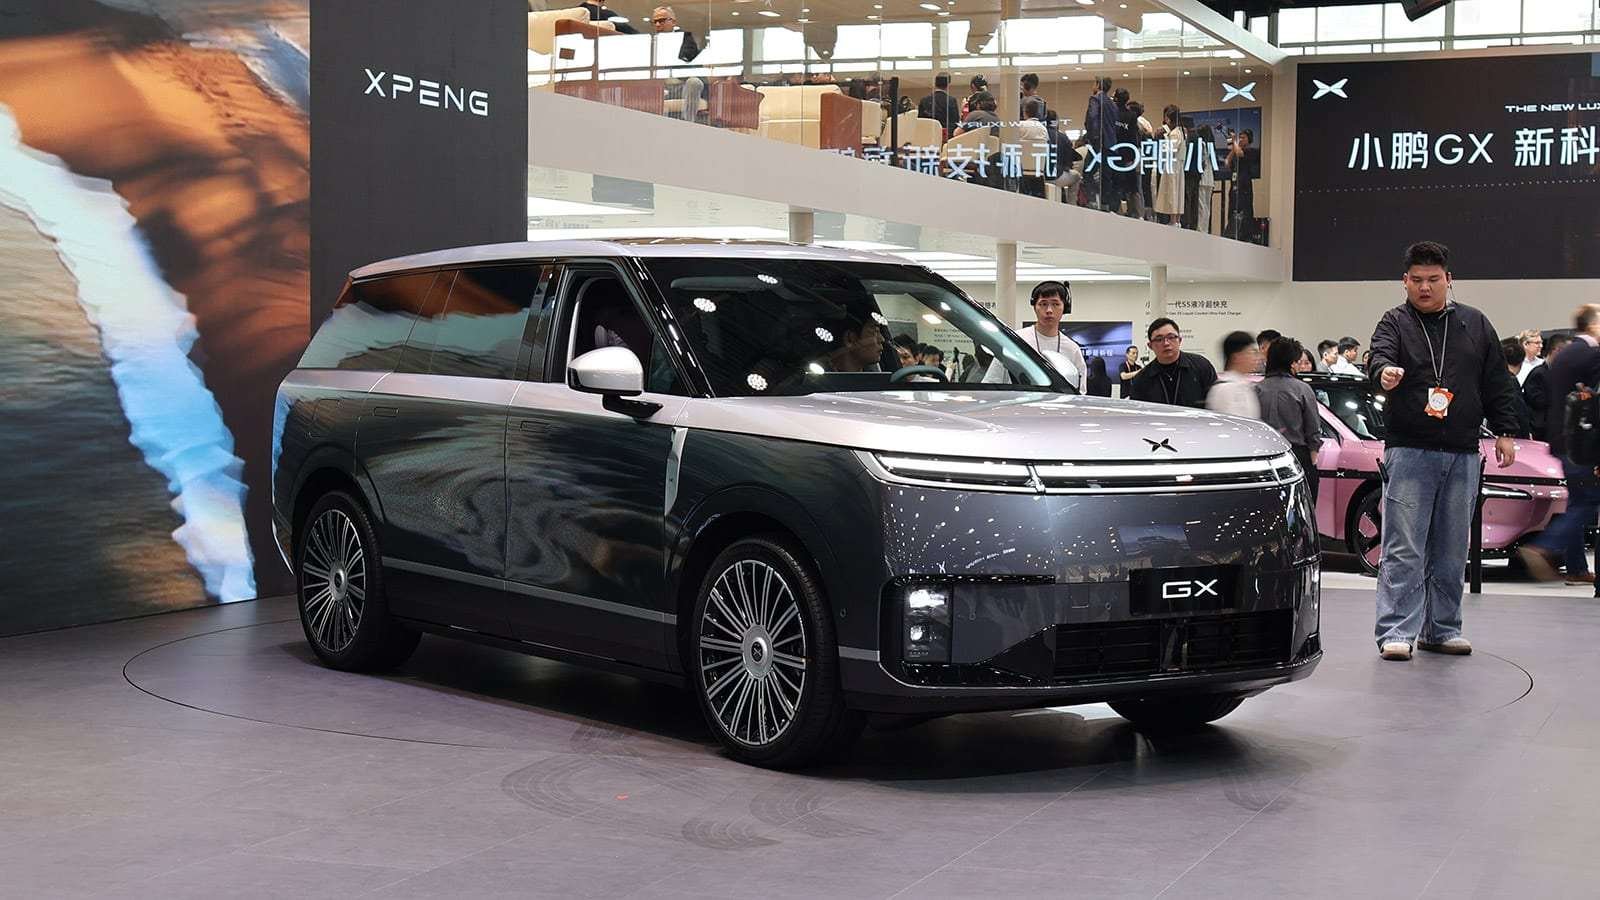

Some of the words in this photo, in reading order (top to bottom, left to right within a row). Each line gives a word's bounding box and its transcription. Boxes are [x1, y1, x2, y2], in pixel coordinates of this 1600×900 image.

[363, 68, 489, 117] XPENG
[1505, 105, 1538, 113] THE
[1541, 104, 1575, 112] NEW
[1348, 132, 1494, 170] 小鹏GX
[1515, 126, 1600, 166] 新科
[1162, 579, 1219, 599] GX
